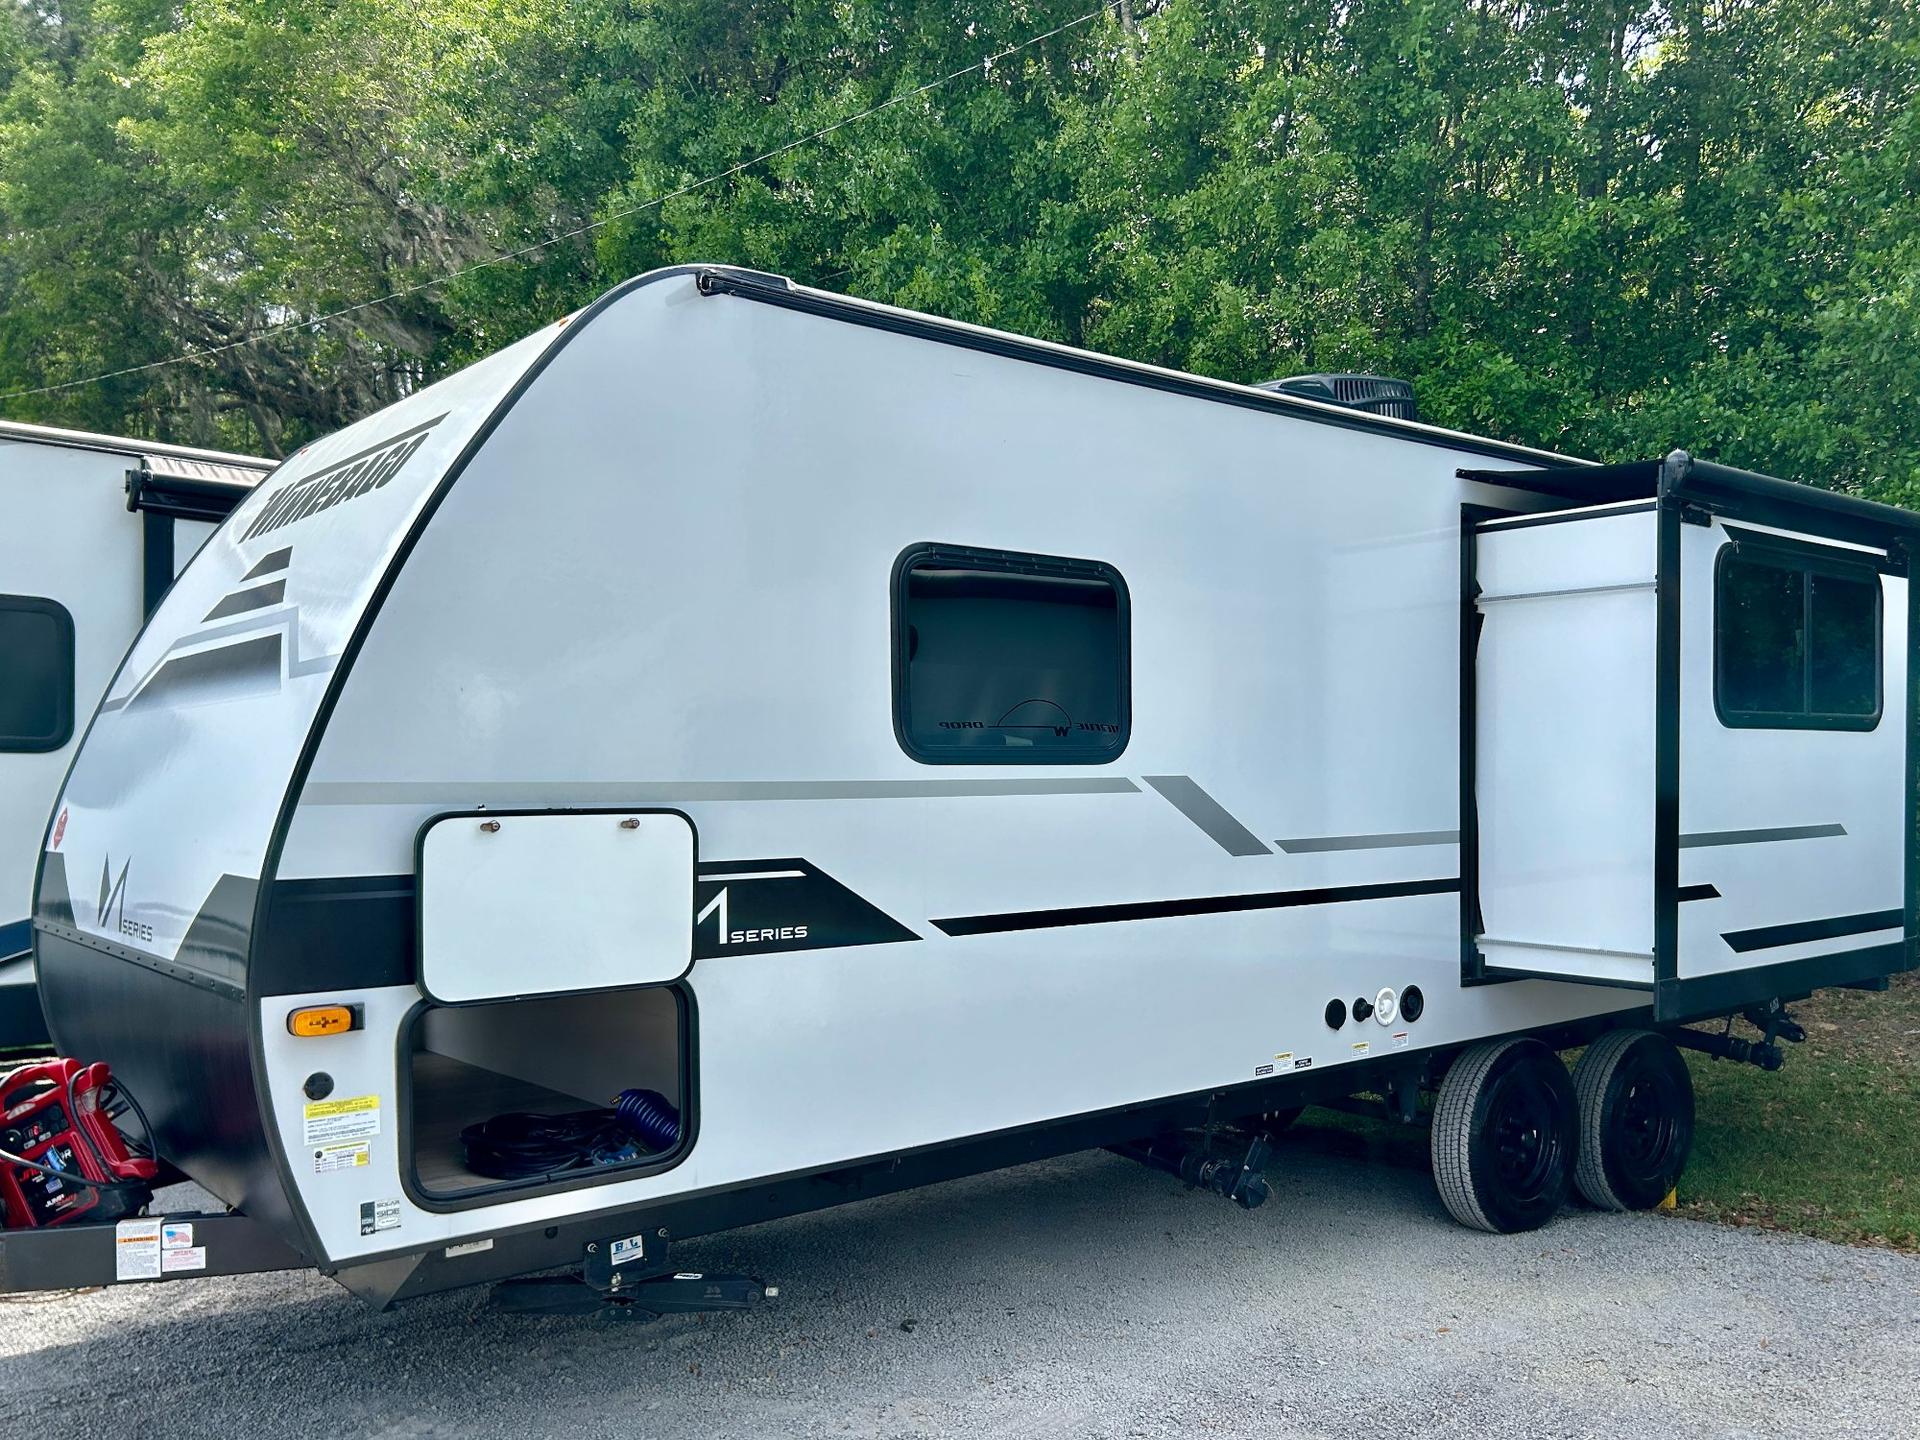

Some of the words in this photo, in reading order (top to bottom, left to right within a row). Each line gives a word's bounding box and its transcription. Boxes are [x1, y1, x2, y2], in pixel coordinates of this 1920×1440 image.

[238, 432, 430, 544] WINNEBAGO
[122, 919, 153, 942] SERIES
[730, 925, 808, 944] SERIES
